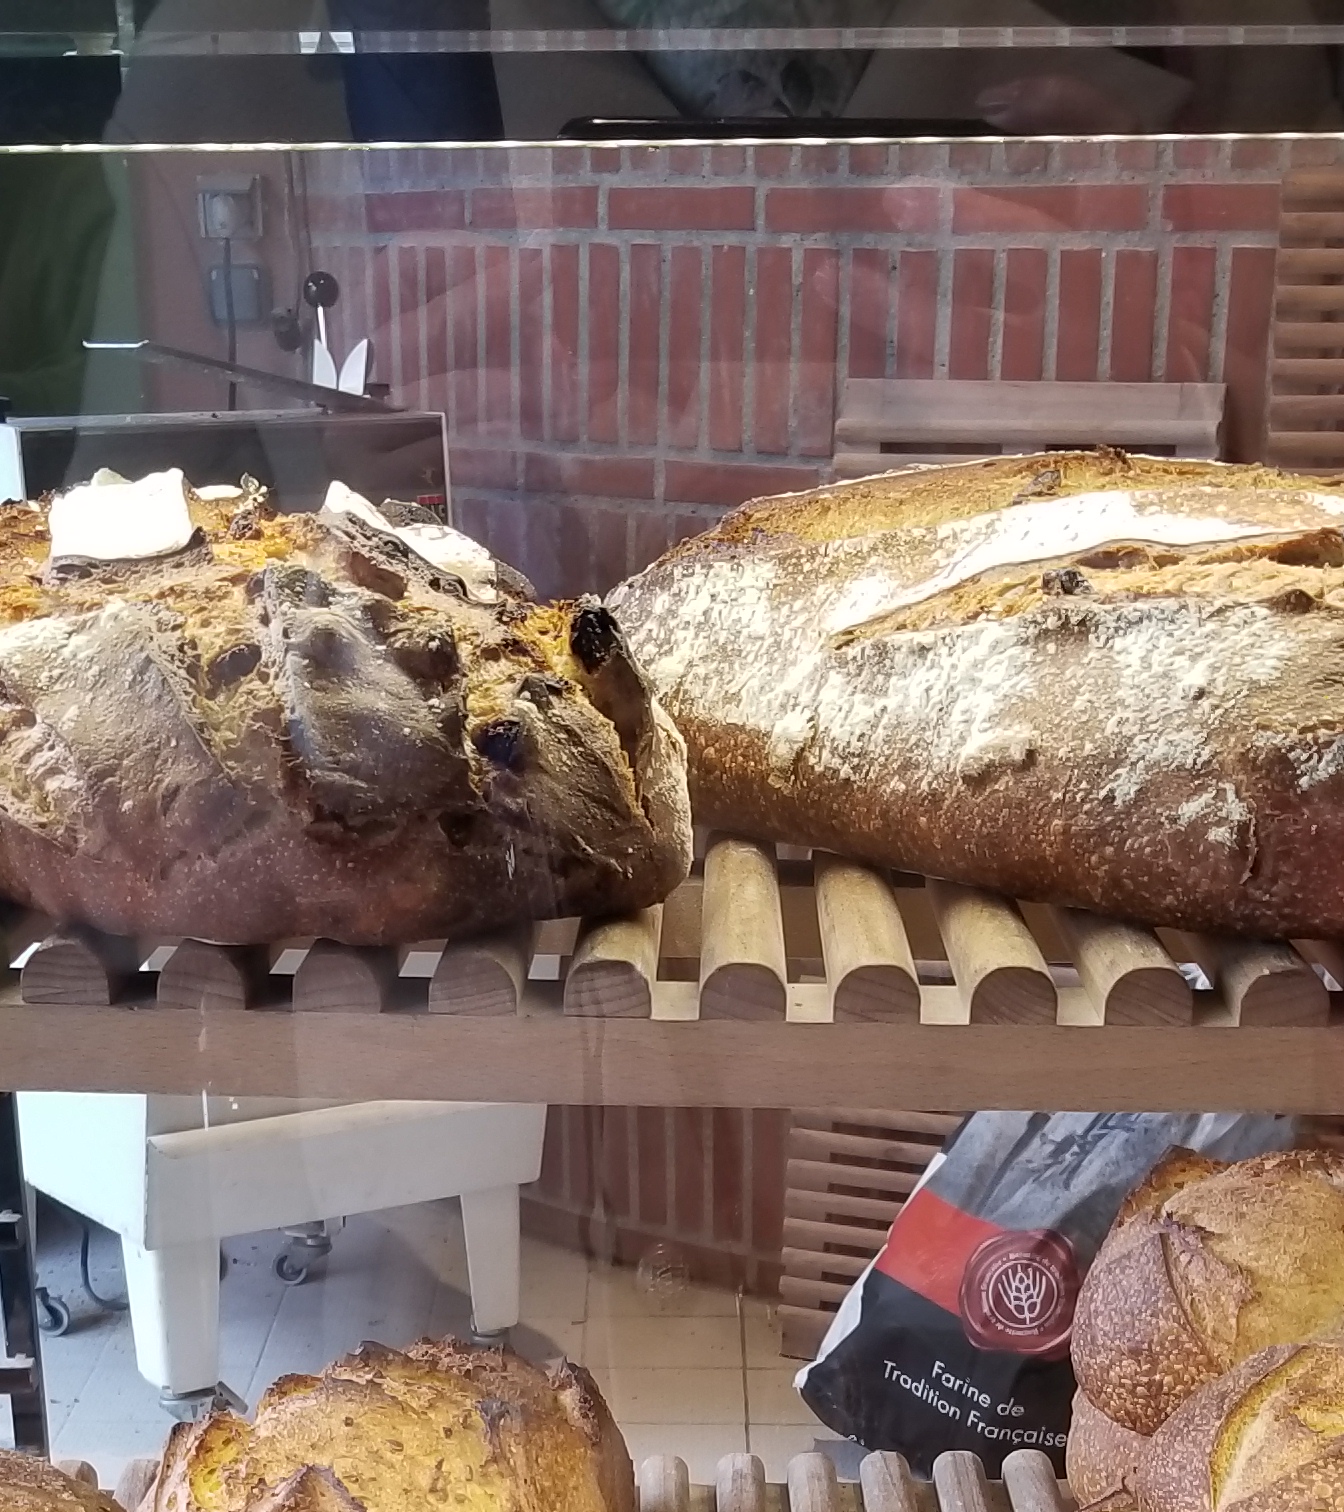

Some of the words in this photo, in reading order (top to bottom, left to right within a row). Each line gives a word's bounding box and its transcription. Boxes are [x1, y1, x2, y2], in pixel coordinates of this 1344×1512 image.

[883, 1359, 960, 1421] Tradition
[966, 1410, 1067, 1448] Française
[931, 1360, 992, 1408] Farine
[996, 1397, 1025, 1417] de
